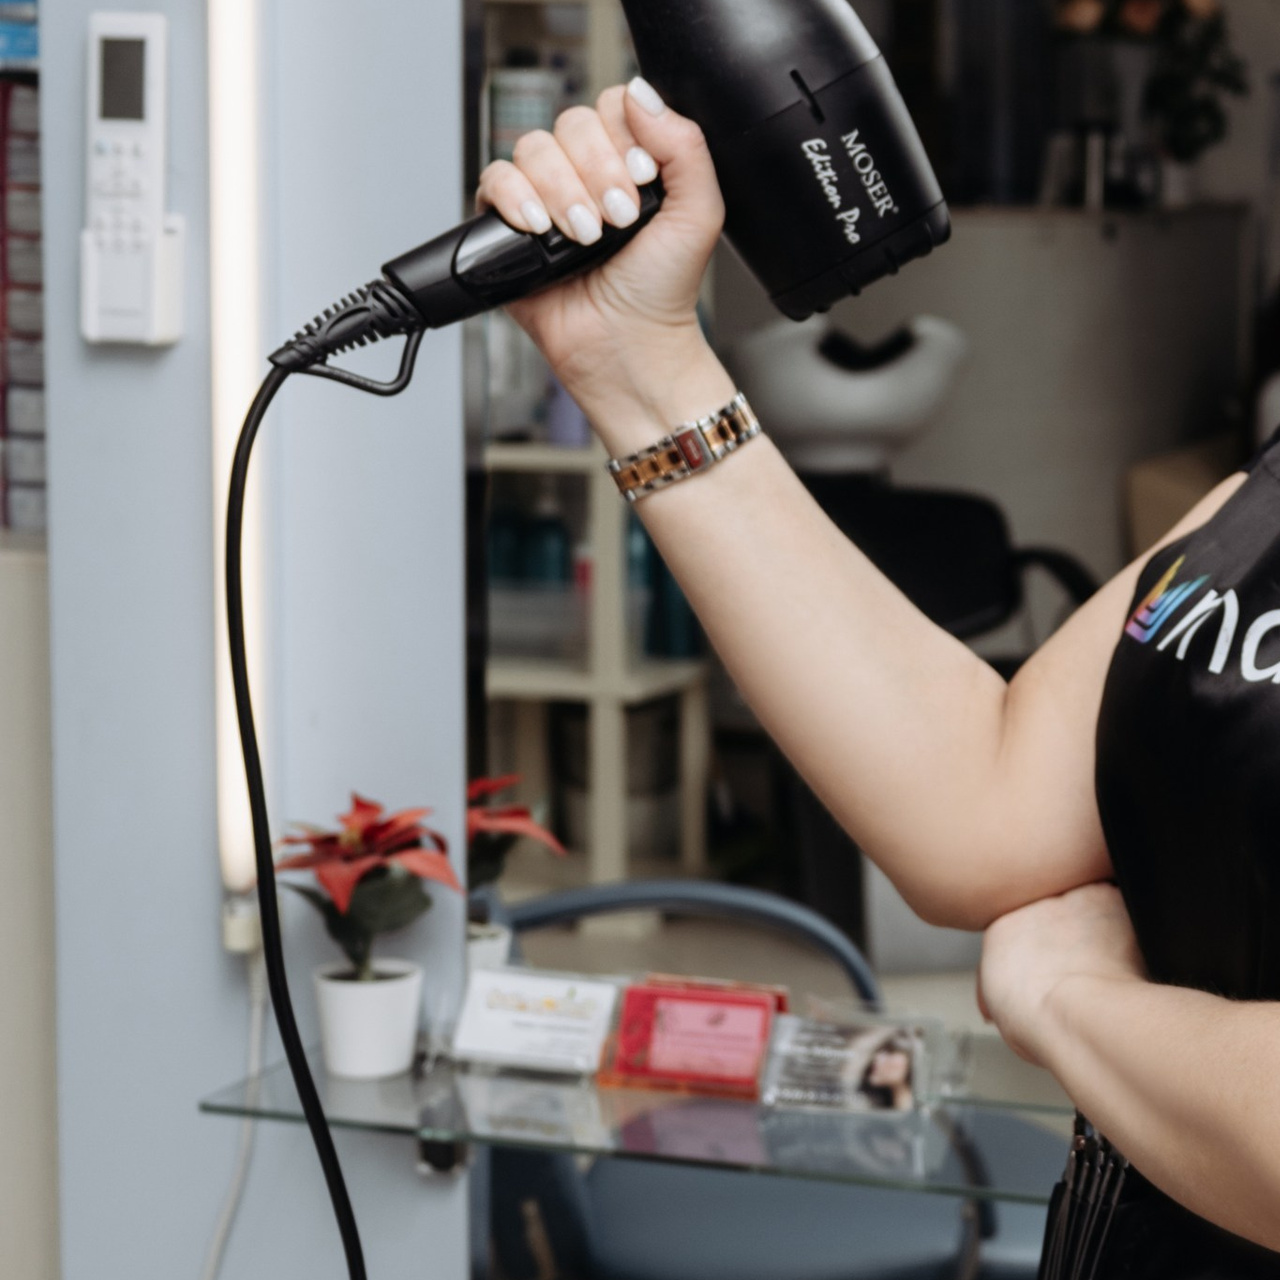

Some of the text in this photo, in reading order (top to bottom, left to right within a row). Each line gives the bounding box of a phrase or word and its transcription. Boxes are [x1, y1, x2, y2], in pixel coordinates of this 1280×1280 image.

[801, 138, 861, 244] Edition Pro
[841, 128, 894, 218] MOSER
